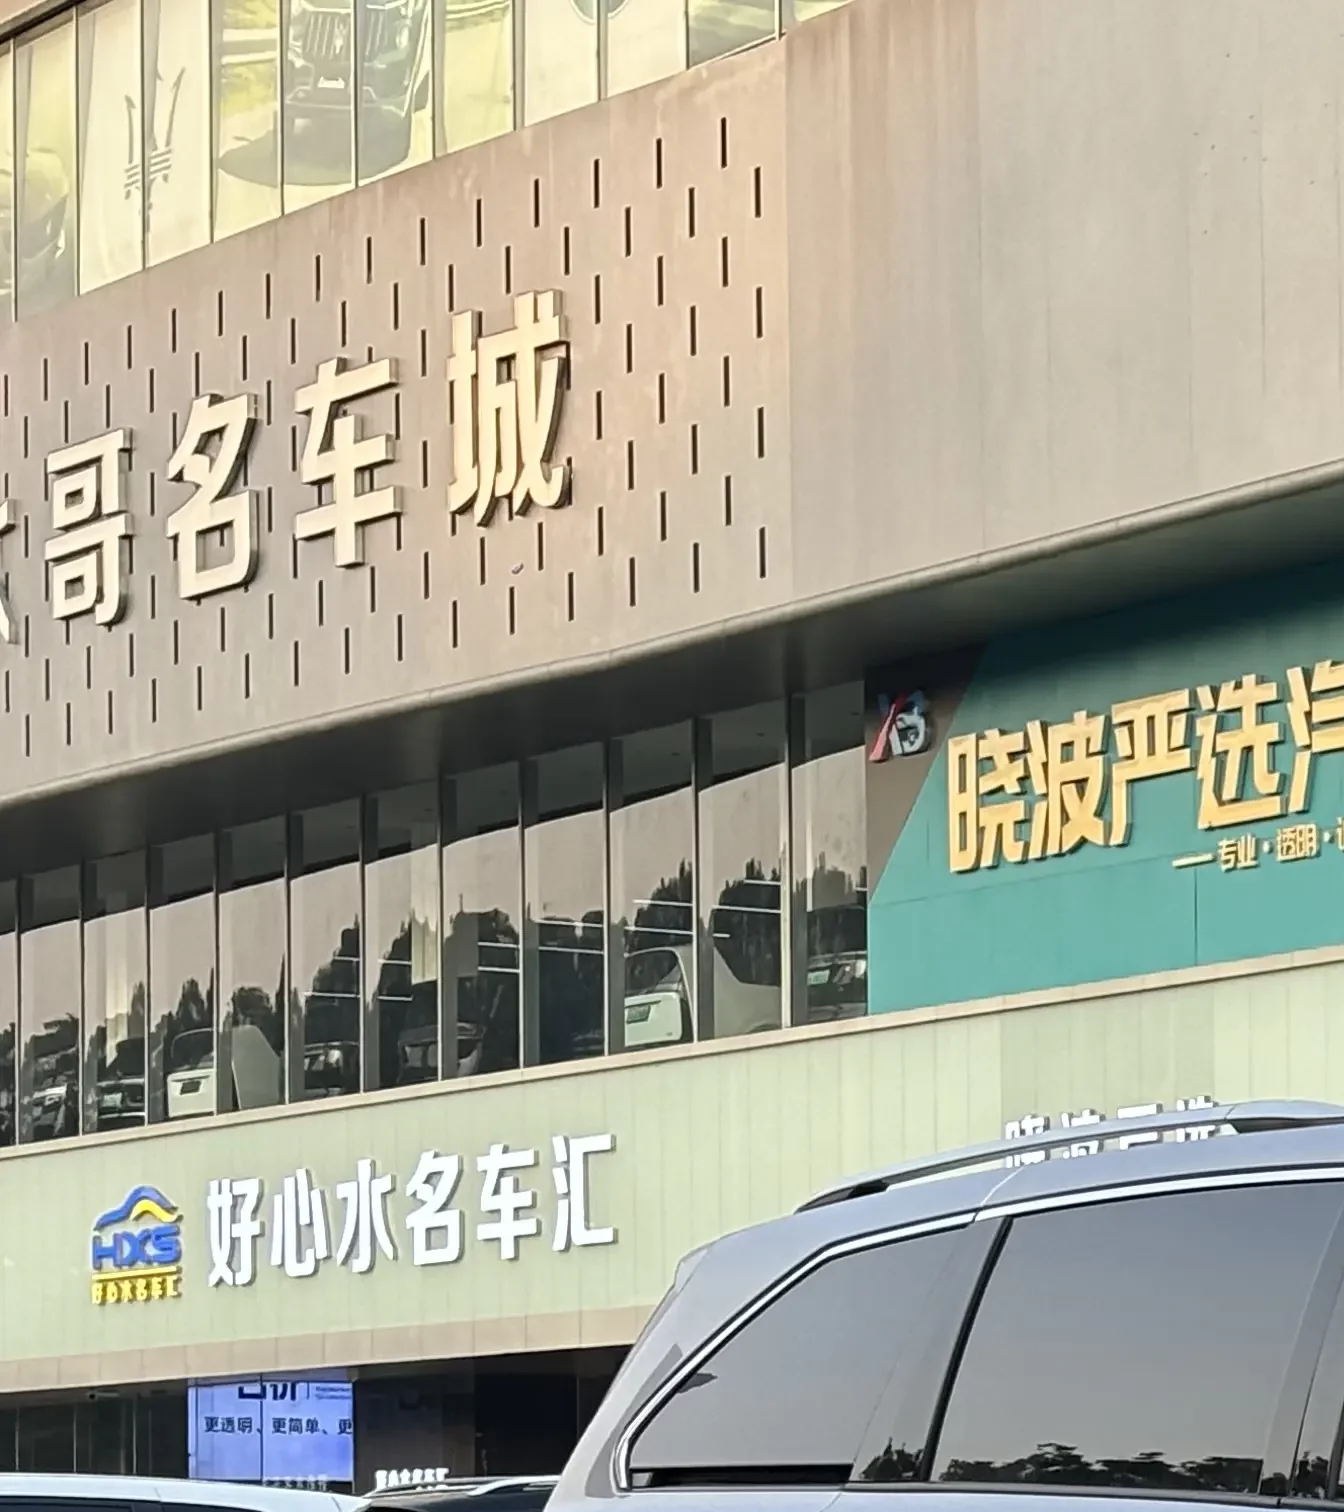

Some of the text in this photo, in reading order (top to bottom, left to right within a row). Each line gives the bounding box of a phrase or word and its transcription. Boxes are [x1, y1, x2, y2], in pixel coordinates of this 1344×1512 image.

[0, 289, 571, 645] 哥名车城
[207, 1133, 616, 1288] 好心水名车汇
